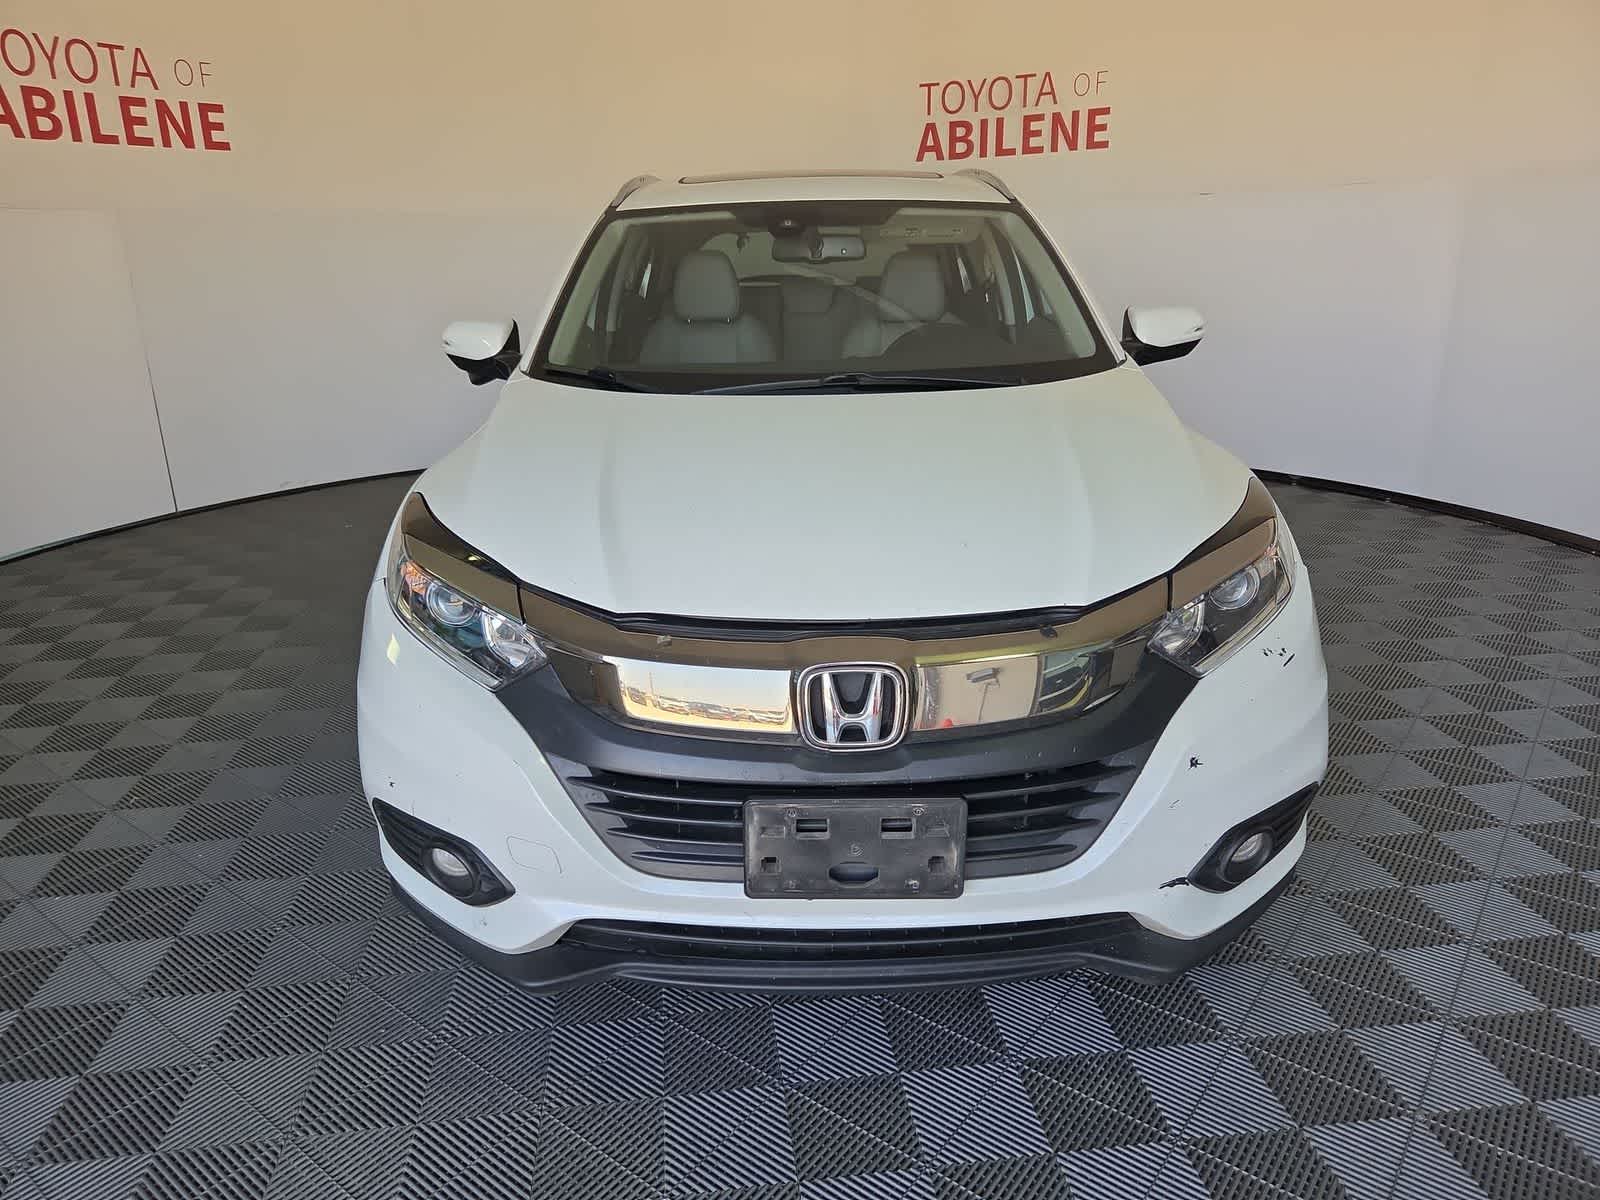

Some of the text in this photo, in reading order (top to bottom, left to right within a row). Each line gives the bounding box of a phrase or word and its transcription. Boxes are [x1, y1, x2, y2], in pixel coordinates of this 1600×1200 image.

[174, 58, 212, 87] OF
[919, 70, 1109, 116] TOYOTA OF
[916, 106, 1111, 162] ABILENE
